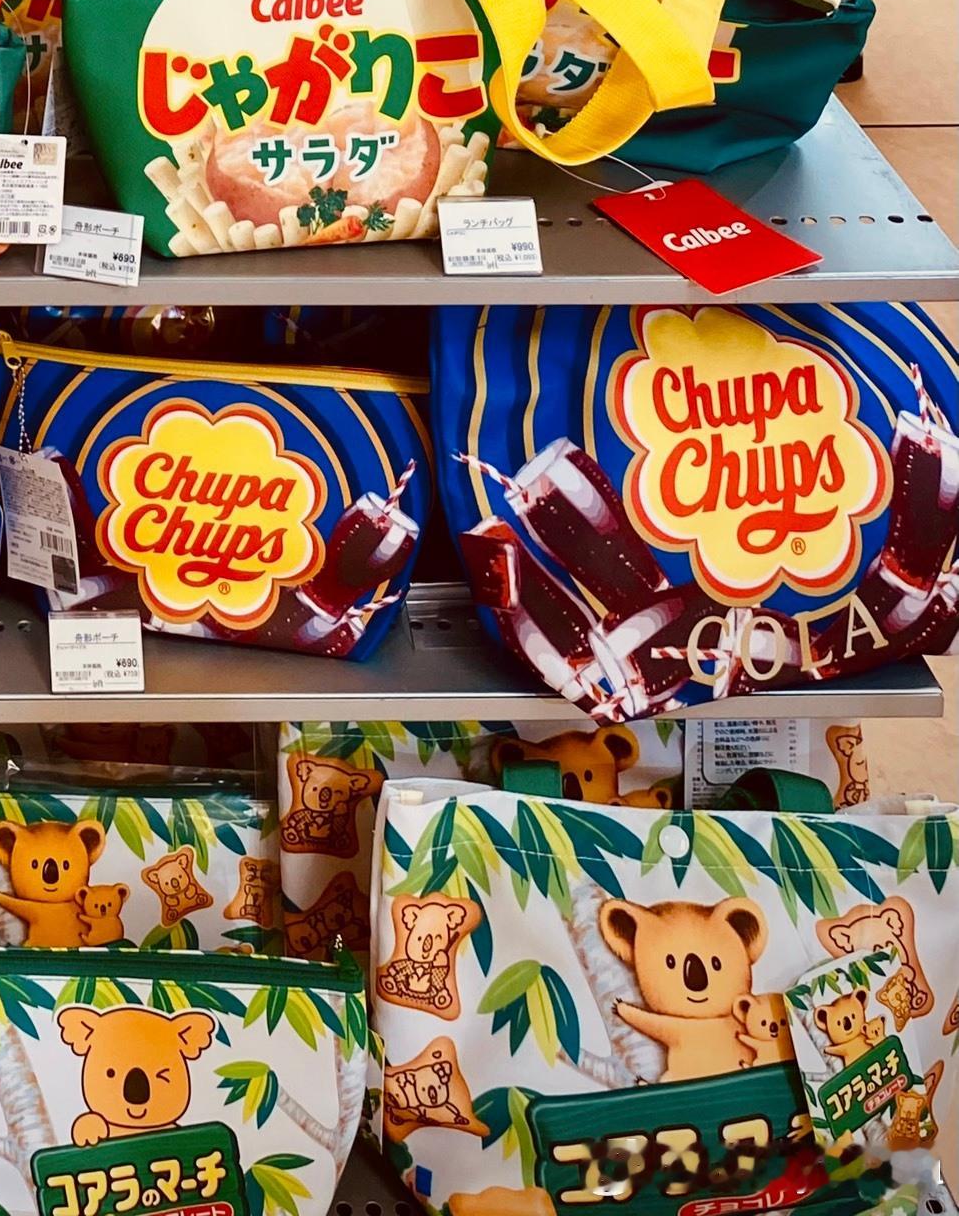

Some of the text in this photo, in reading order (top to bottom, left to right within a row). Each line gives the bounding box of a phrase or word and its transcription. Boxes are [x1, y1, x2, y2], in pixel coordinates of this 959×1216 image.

[143, 24, 484, 137] じゃがりこ
[252, 134, 397, 183] サラダ
[463, 217, 514, 228] ランチバッグ
[663, 219, 752, 254] Calbee
[652, 364, 825, 443] Chupa
[133, 452, 297, 520] Chupa
[660, 434, 845, 555] Chups
[123, 504, 289, 585] Chups
[116, 658, 138, 668] ¥690
[687, 593, 889, 686] COLA
[825, 1047, 900, 1121] コアラのマーチ
[47, 1150, 227, 1216] コアラのマーチ
